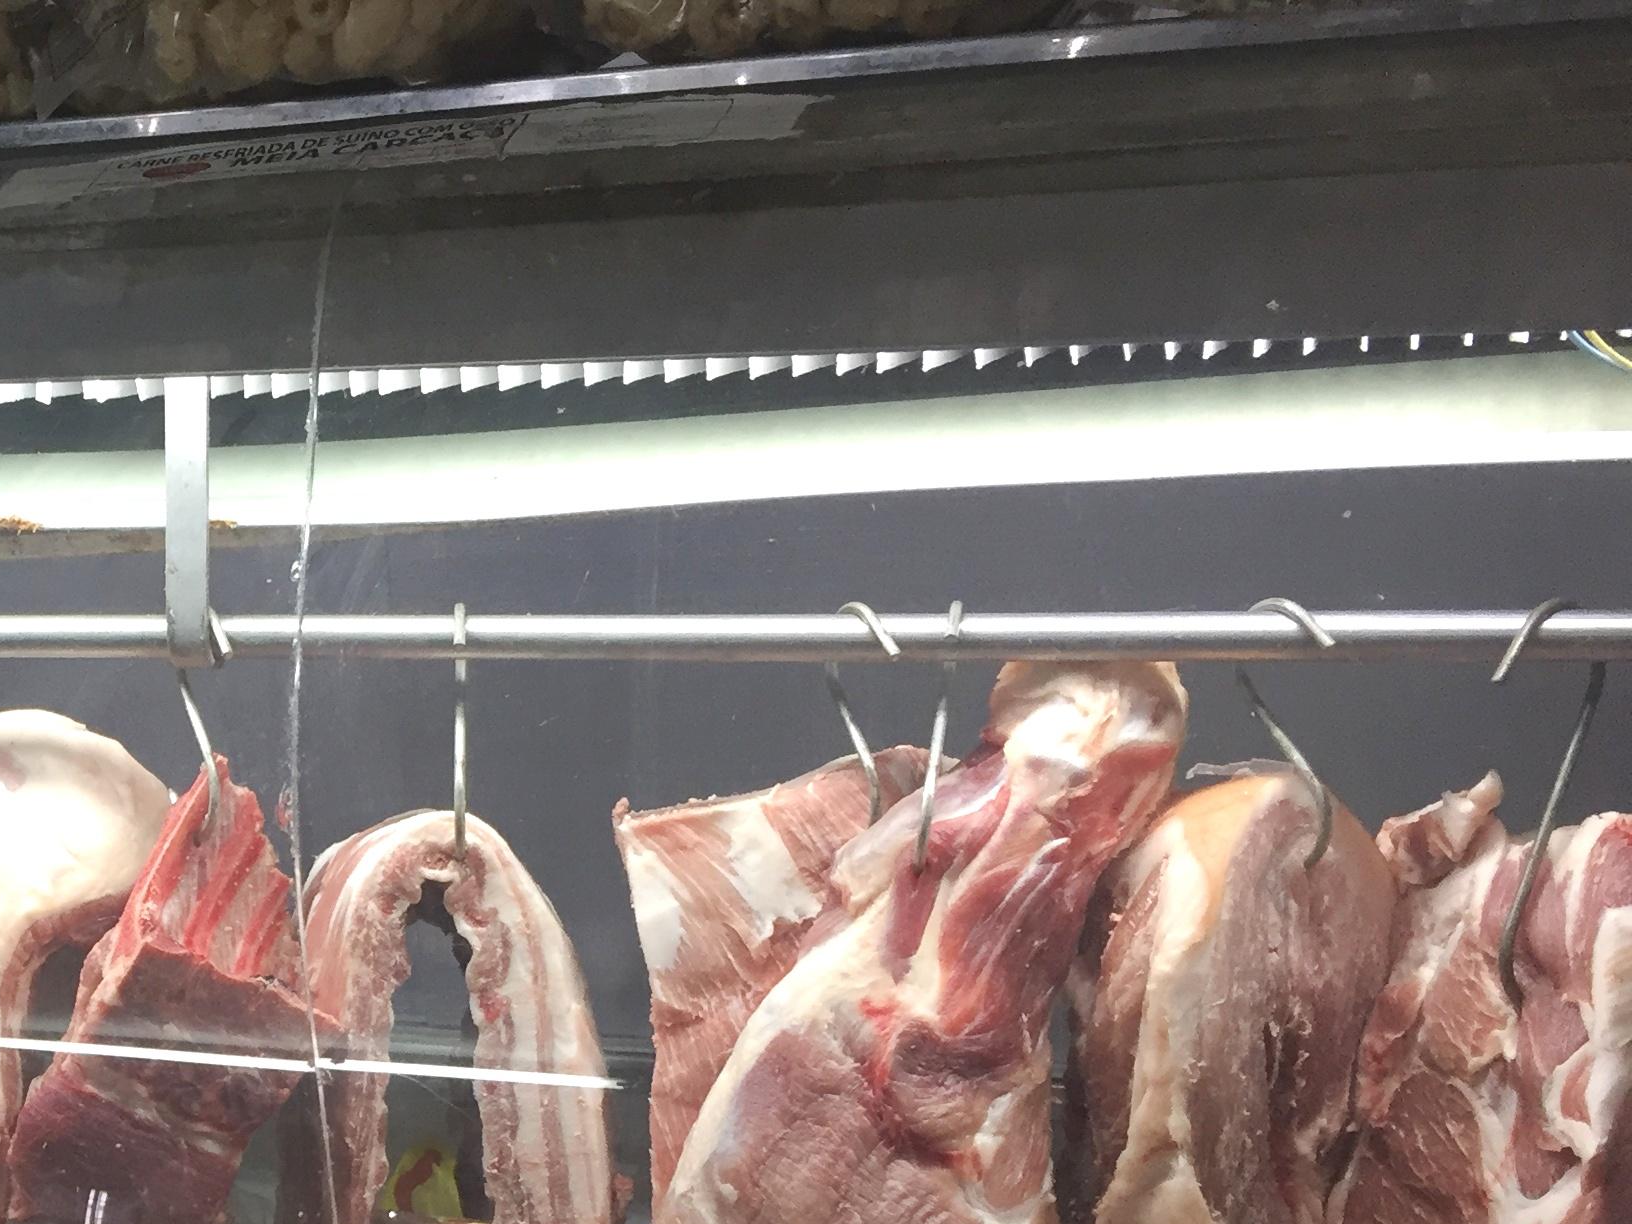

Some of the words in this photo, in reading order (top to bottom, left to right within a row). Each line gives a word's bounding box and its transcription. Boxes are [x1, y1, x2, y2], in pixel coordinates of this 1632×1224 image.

[117, 156, 180, 170] CARNE
[186, 140, 296, 162] RESFRIADA
[300, 136, 332, 149] DE
[405, 123, 454, 137] COM
[459, 117, 516, 130] OO
[230, 148, 320, 167] MEIA
